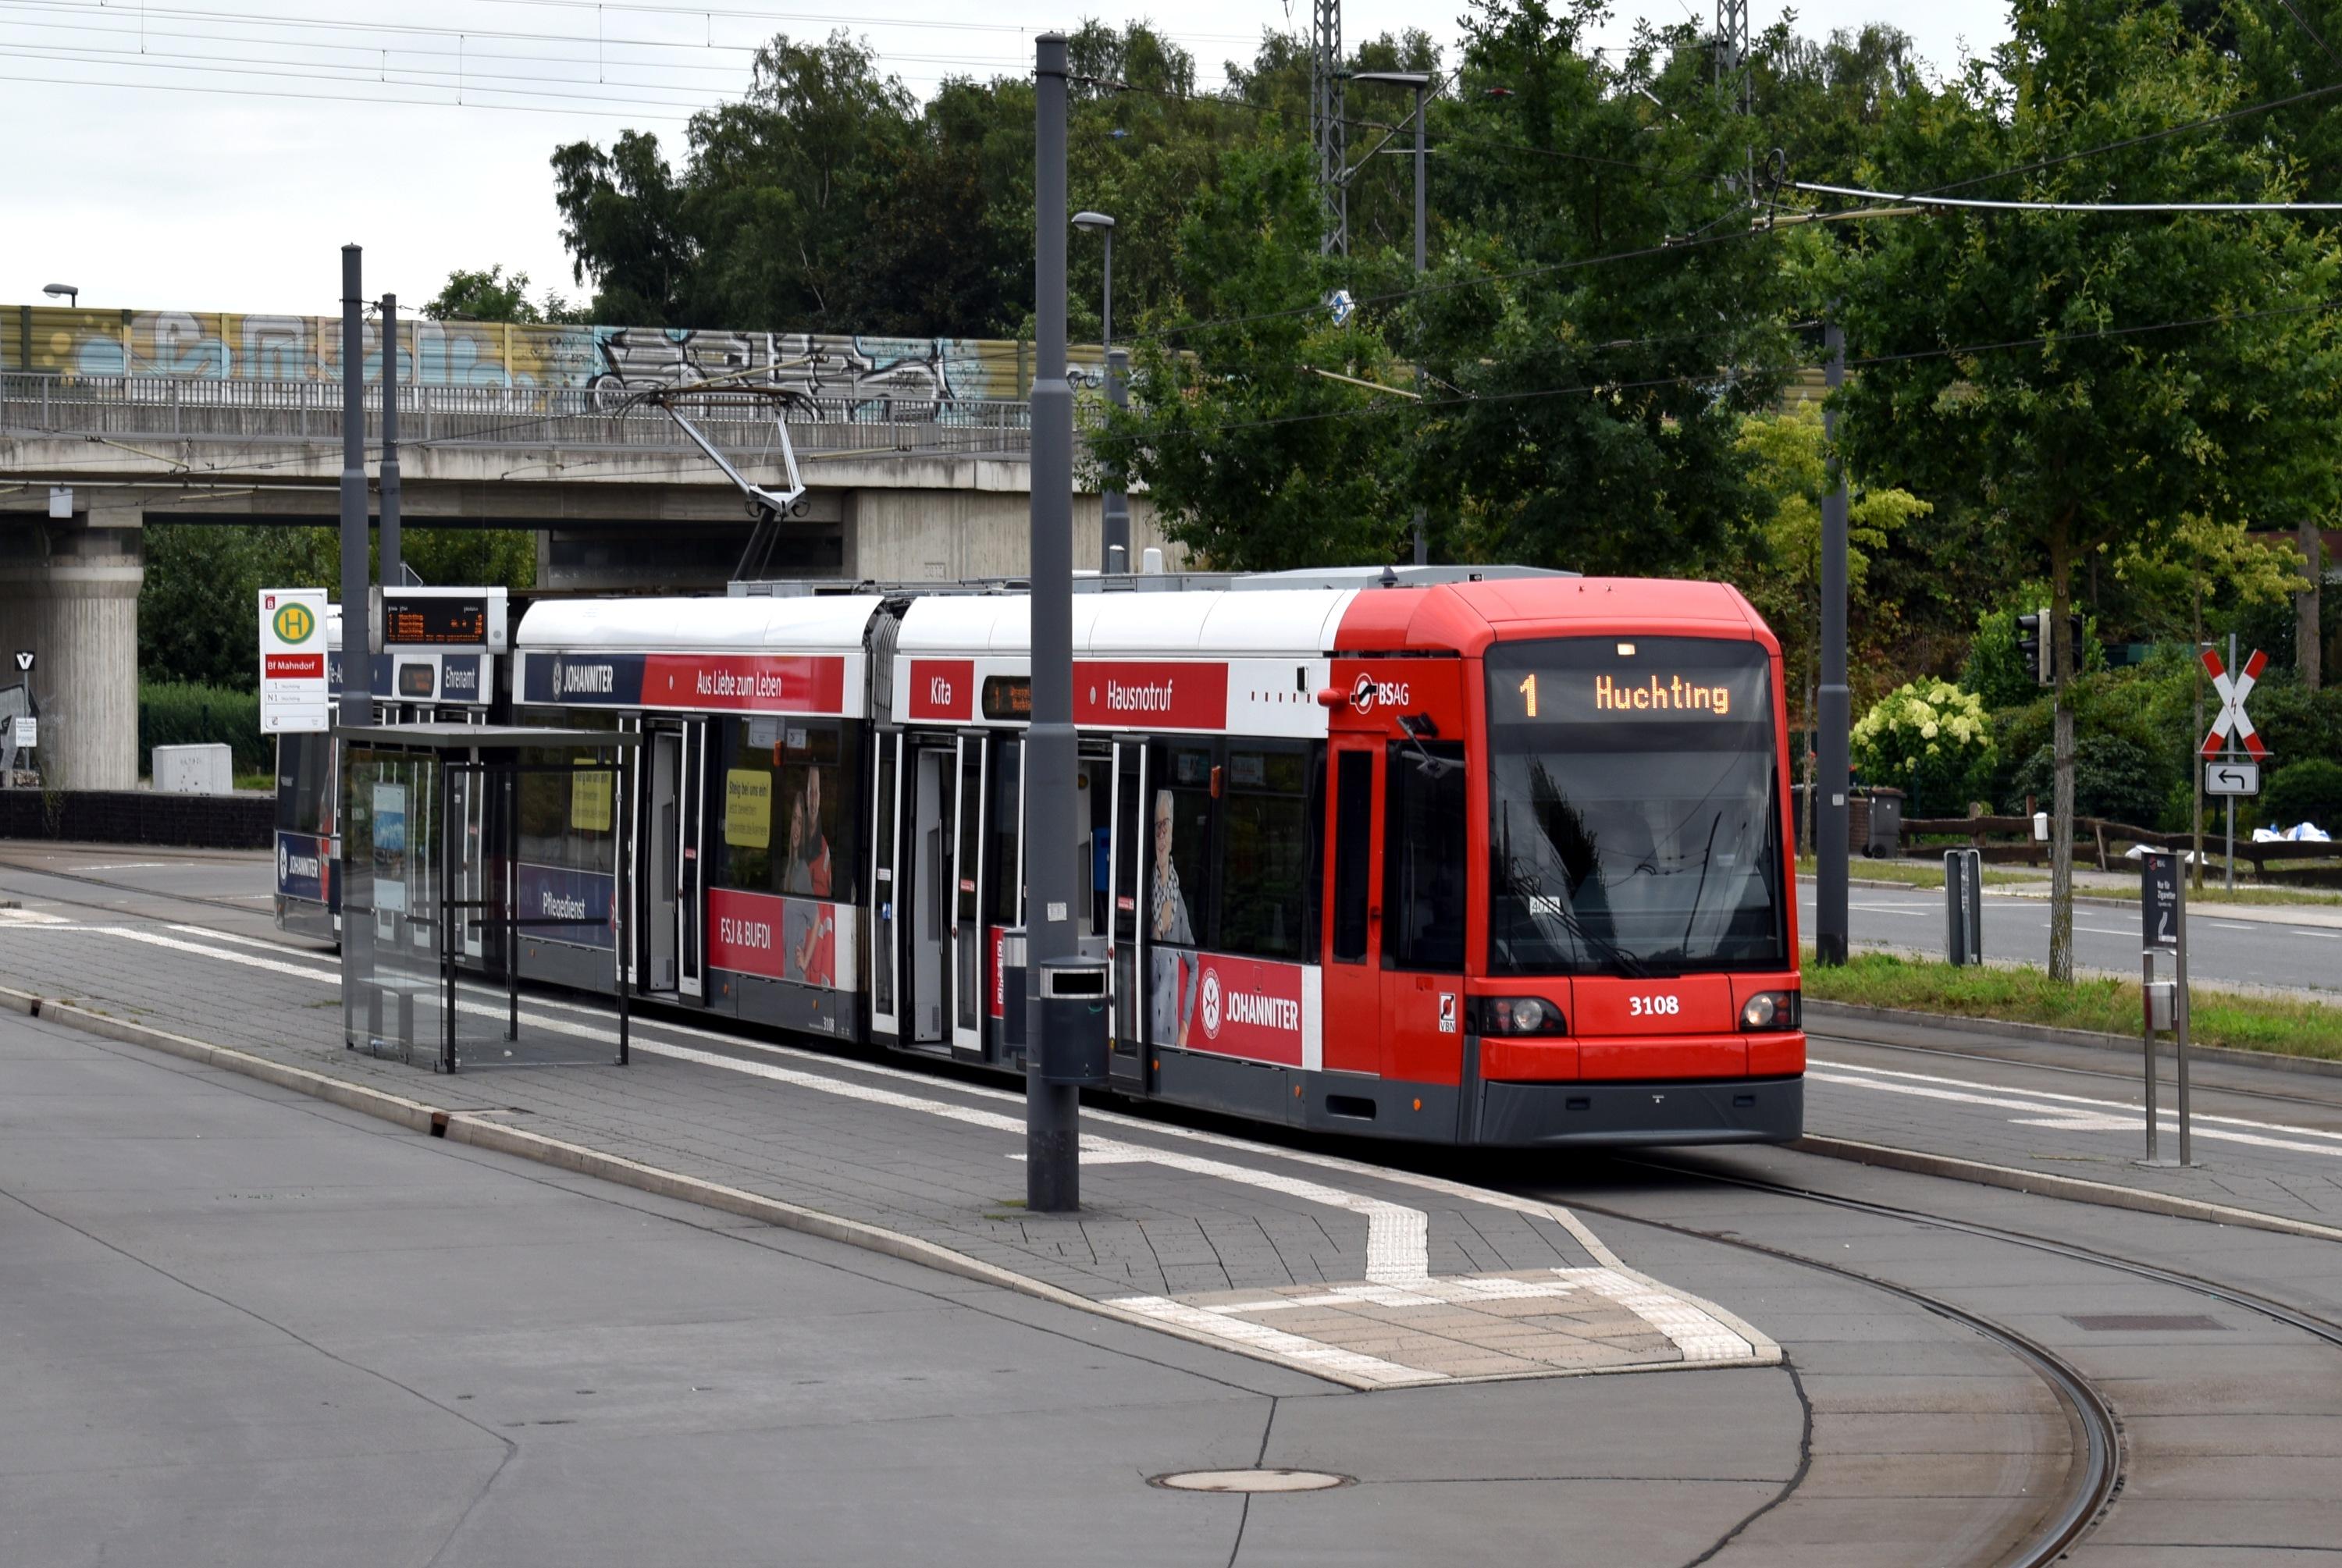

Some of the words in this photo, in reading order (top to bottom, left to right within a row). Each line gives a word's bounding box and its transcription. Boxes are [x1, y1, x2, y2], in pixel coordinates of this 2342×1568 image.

[286, 613, 303, 636] H
[267, 661, 276, 670] Bf
[277, 660, 315, 670] Mahndorf
[446, 665, 475, 689] Ehrenamt
[564, 665, 614, 693] JOHANNITER
[696, 670, 712, 695] Aus
[714, 670, 735, 696] Liebe
[736, 679, 755, 697] zum
[756, 671, 781, 697] Leben
[931, 677, 952, 705] Kita
[1107, 679, 1173, 712] Hausnotruf
[1379, 682, 1409, 706] BSAG
[1520, 674, 1536, 716] 1
[1596, 675, 1728, 714] Huchting
[729, 781, 741, 798] Steig
[750, 785, 759, 796] uns
[289, 855, 318, 878] JOHANNITER
[543, 891, 586, 919] Pflegedienst
[721, 917, 735, 944] FSJ
[736, 919, 742, 946] &
[745, 921, 771, 950] BUFDI
[1226, 990, 1298, 1031] JOHANNITER
[1628, 995, 1679, 1015] 3108
[1441, 1022, 1455, 1032] VBN
